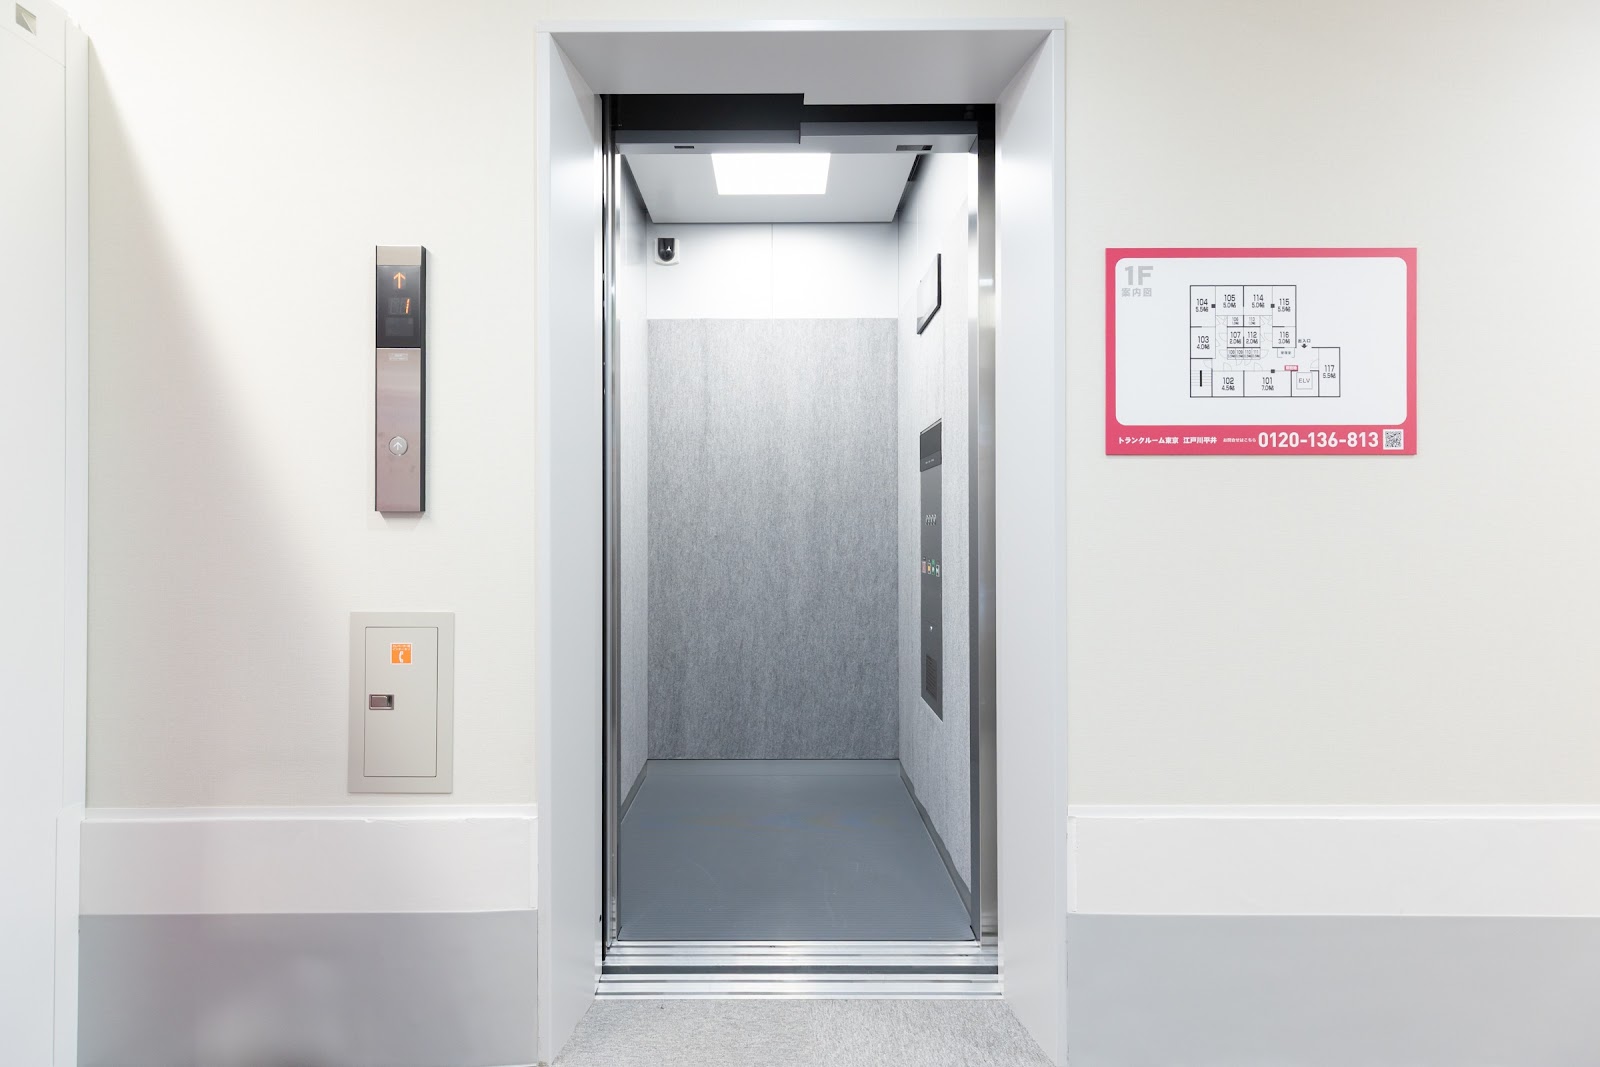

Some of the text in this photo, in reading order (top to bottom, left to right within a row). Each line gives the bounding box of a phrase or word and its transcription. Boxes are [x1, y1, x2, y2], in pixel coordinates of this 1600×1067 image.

[1124, 265, 1153, 286] 1F
[1121, 287, 1153, 298] 案内図
[1196, 298, 1208, 306] 104
[1224, 294, 1236, 302] 105
[1253, 294, 1264, 302] 114
[1279, 298, 1290, 306] 115
[405, 298, 411, 314] 1
[1197, 335, 1209, 343] 103
[1230, 331, 1241, 339] 107
[1247, 331, 1258, 339] 112
[1222, 377, 1234, 385] 102
[1262, 377, 1273, 385] 101
[1118, 436, 1180, 445] トランクルーム東京
[1183, 436, 1218, 445] 江戸川平井
[1257, 431, 1379, 448] 0120-136-813
